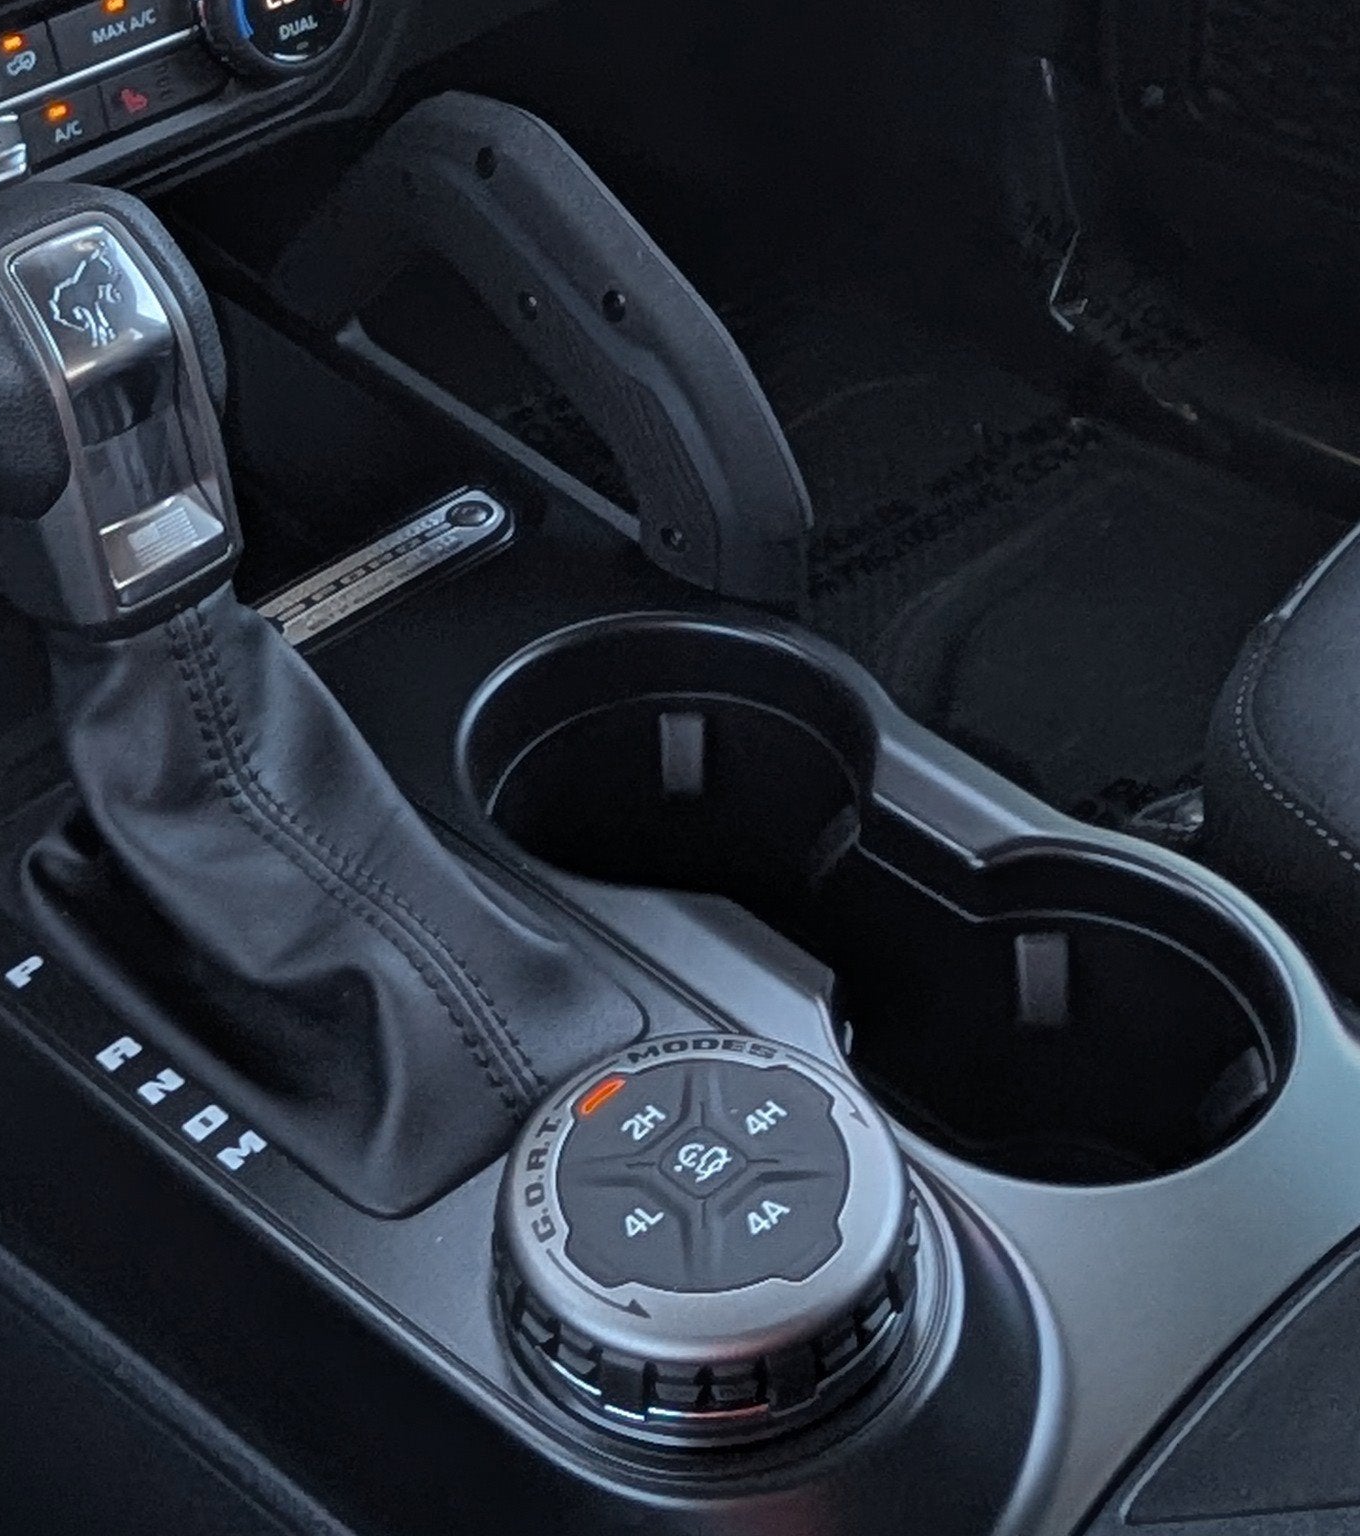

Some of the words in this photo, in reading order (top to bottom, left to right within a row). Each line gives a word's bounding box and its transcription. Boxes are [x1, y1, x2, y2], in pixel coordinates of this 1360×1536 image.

[91, 23, 127, 44] MAX
[129, 7, 156, 30] A/C
[278, 15, 319, 41] DUAL
[54, 120, 83, 144] A/C
[5, 955, 44, 989] P
[95, 1036, 143, 1072] R
[137, 1067, 186, 1105] N
[182, 1104, 230, 1143] D
[216, 1129, 268, 1171] M
[626, 1038, 779, 1064] MODES
[621, 1104, 667, 1142] 2H
[743, 1099, 788, 1136] 4H
[623, 1208, 664, 1240] 4L
[745, 1198, 792, 1238] 4A
